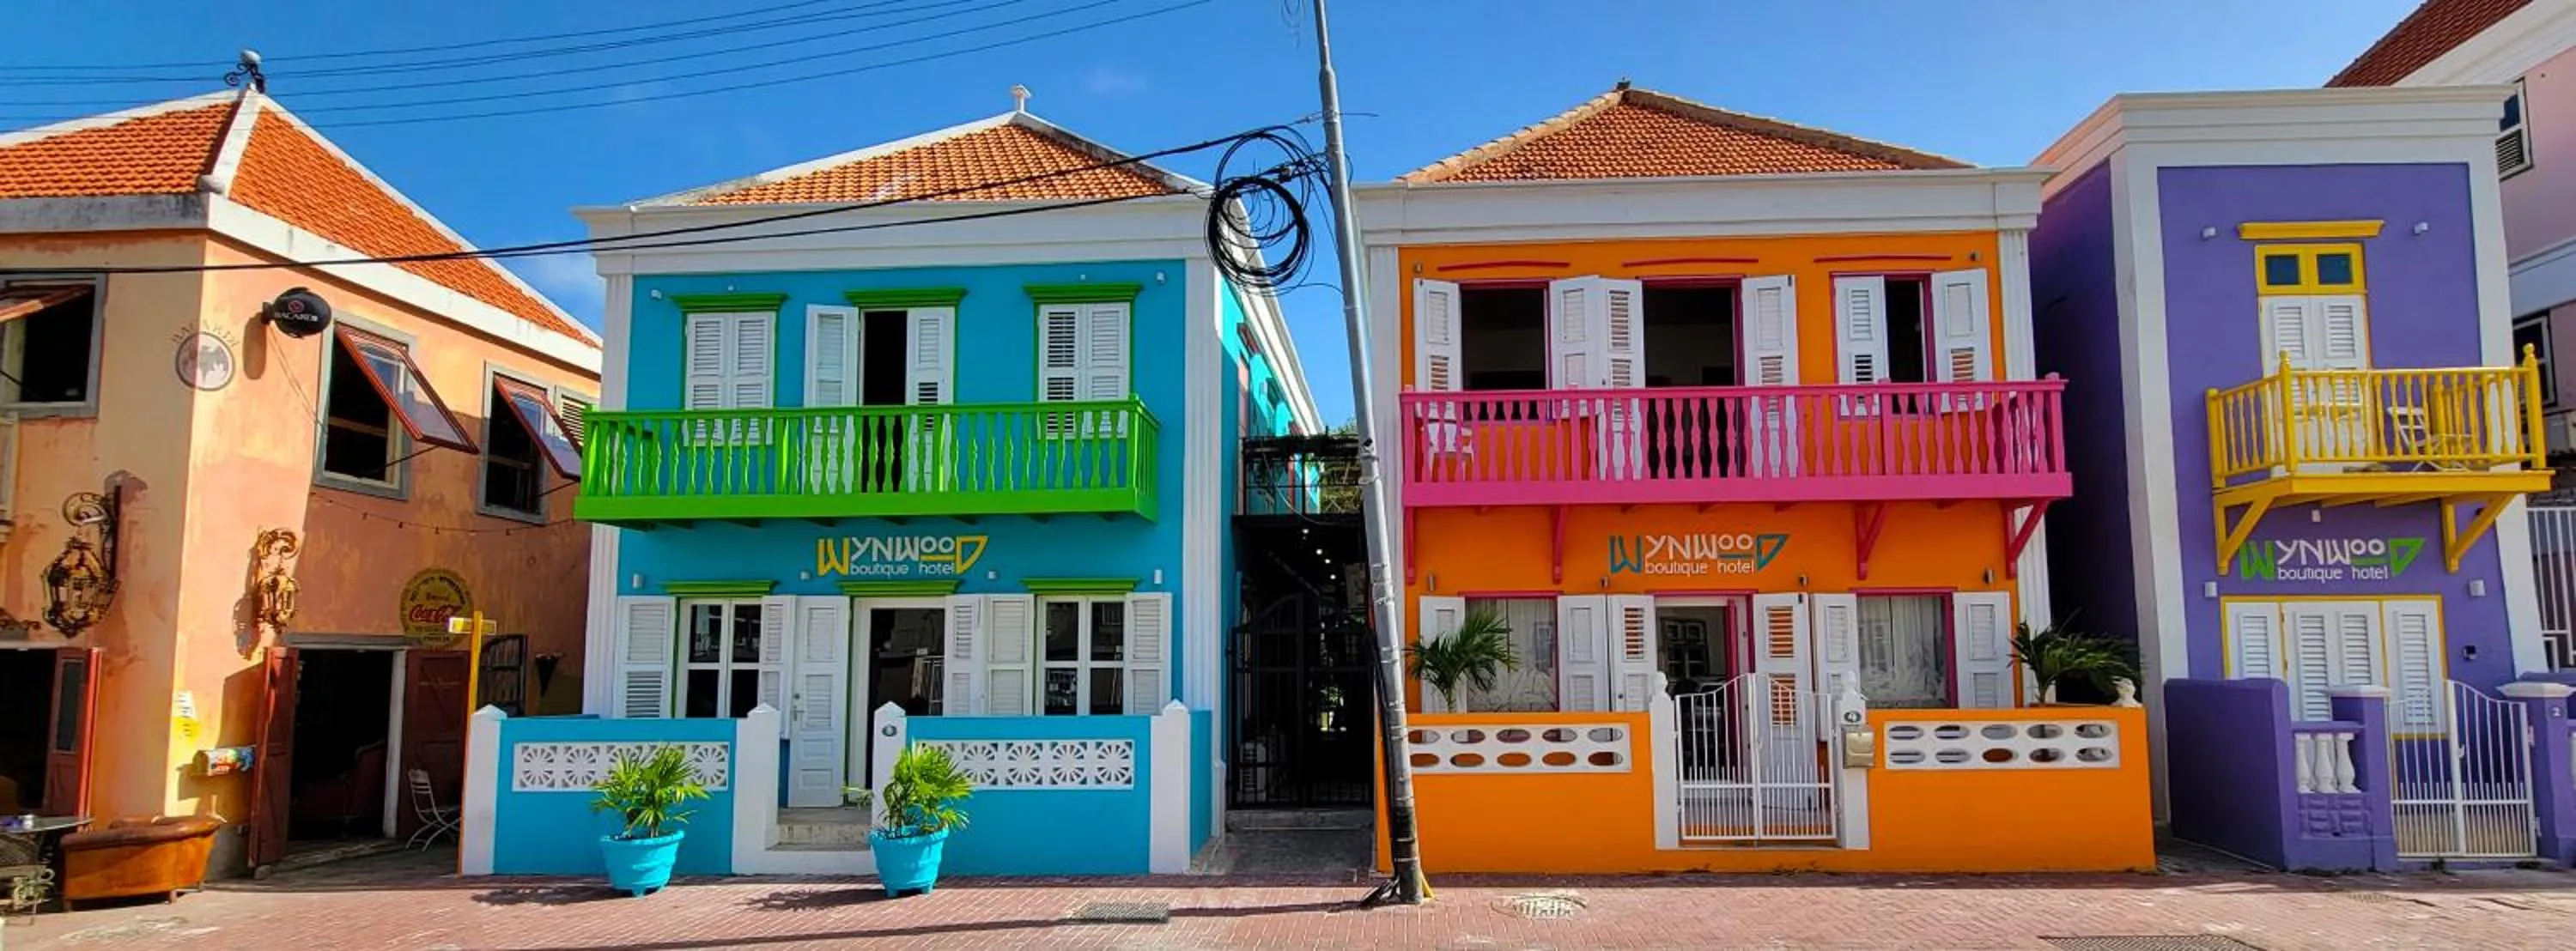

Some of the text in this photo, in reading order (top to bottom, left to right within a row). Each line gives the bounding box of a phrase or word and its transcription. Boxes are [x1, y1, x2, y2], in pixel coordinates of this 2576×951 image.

[851, 562, 956, 578] boutique hotel
[1645, 559, 1755, 577] boutique hotel
[2277, 566, 2389, 584] boutique hotel
